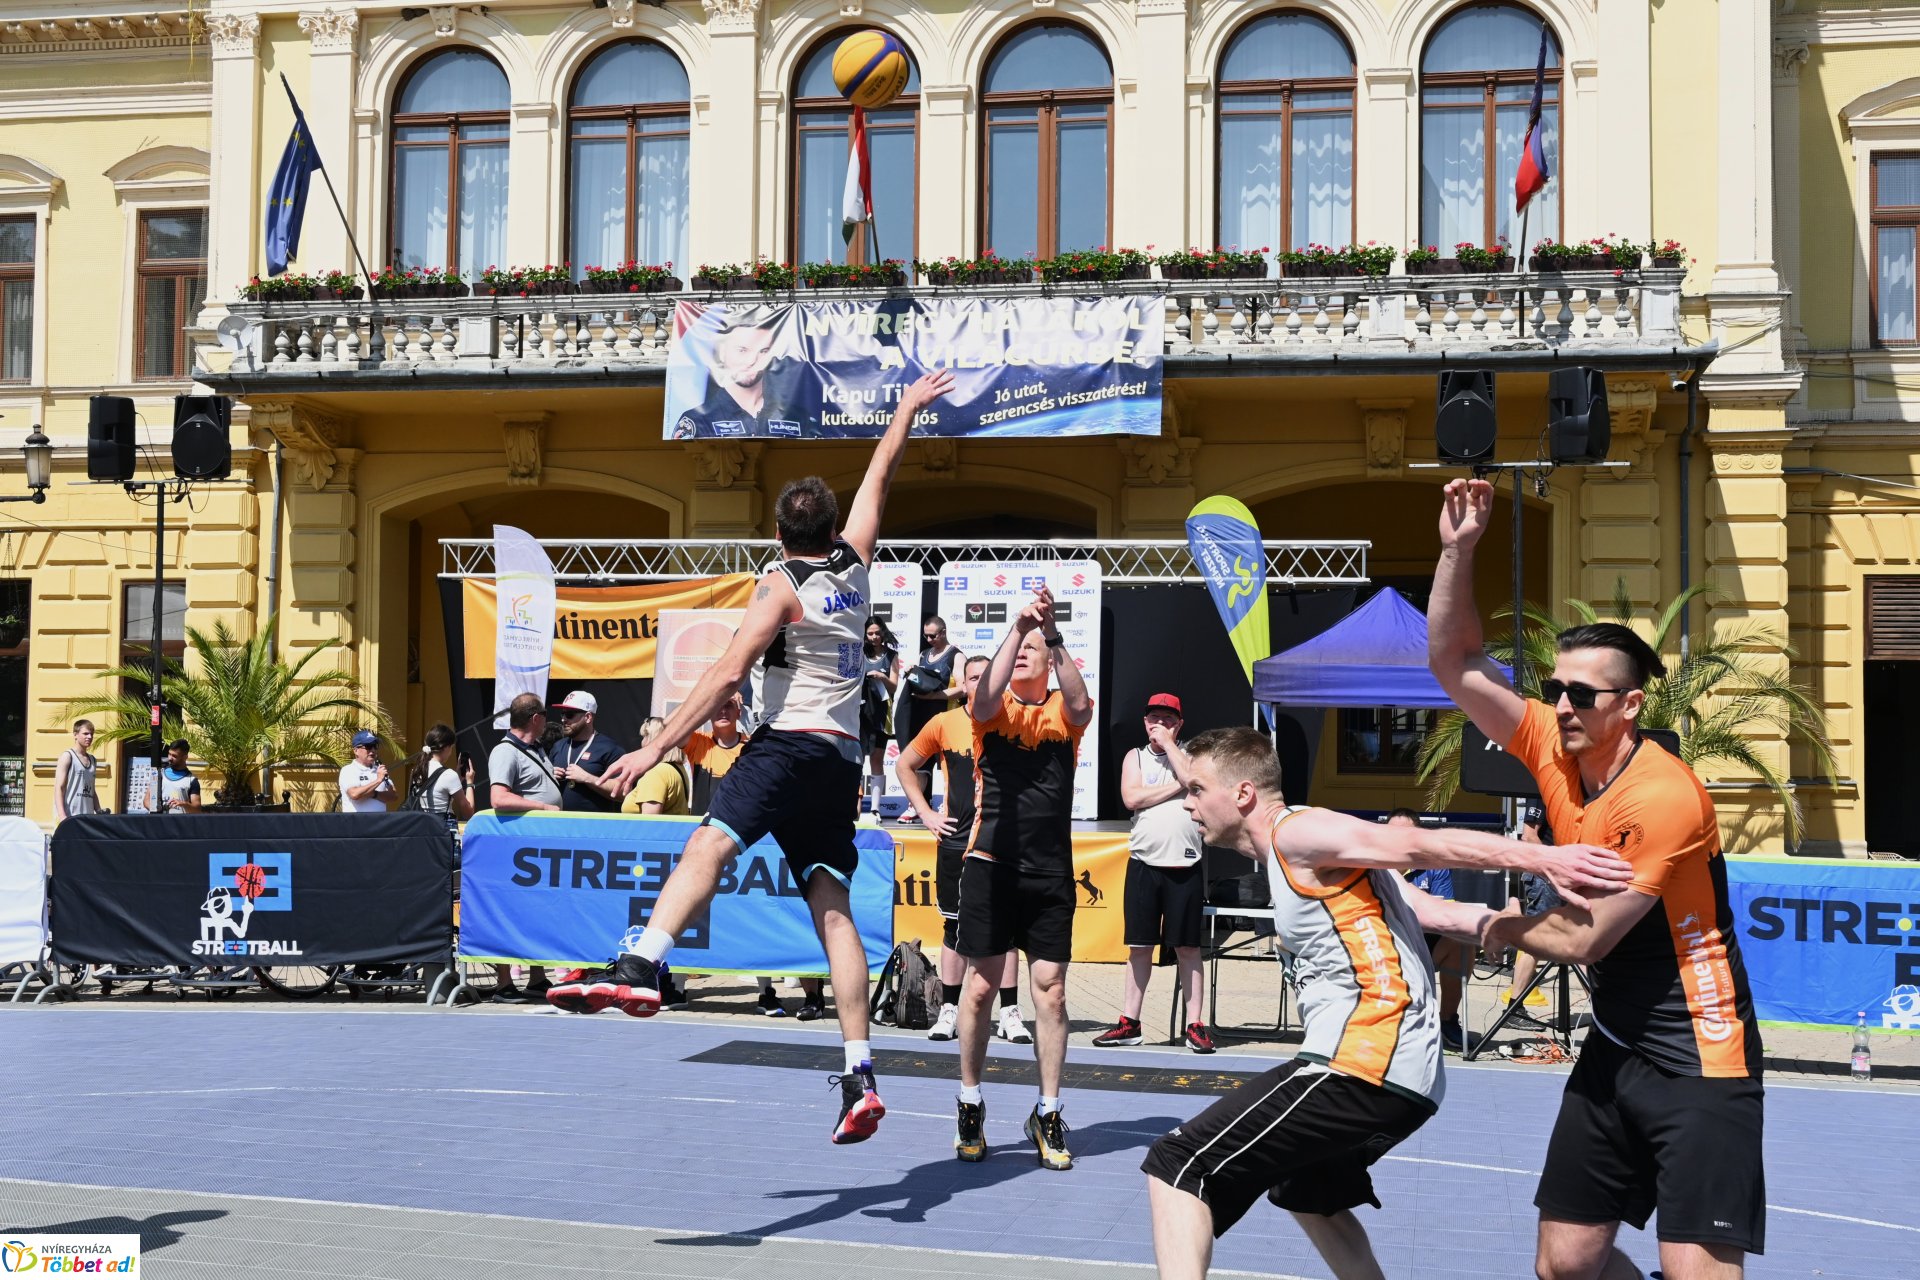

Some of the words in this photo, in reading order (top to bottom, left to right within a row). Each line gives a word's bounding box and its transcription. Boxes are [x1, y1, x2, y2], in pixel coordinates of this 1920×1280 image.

[880, 346, 906, 370] A
[822, 384, 876, 407] Kapu
[979, 395, 1055, 425] szerencsés
[1058, 381, 1147, 407] visszatérést!
[994, 388, 1010, 404] Jó
[1014, 381, 1048, 399] utat,
[821, 410, 939, 428] kutatóűrjós
[511, 847, 803, 897] STREEBAL
[191, 940, 303, 955] STREETBALL
[1716, 961, 1732, 993] Future
